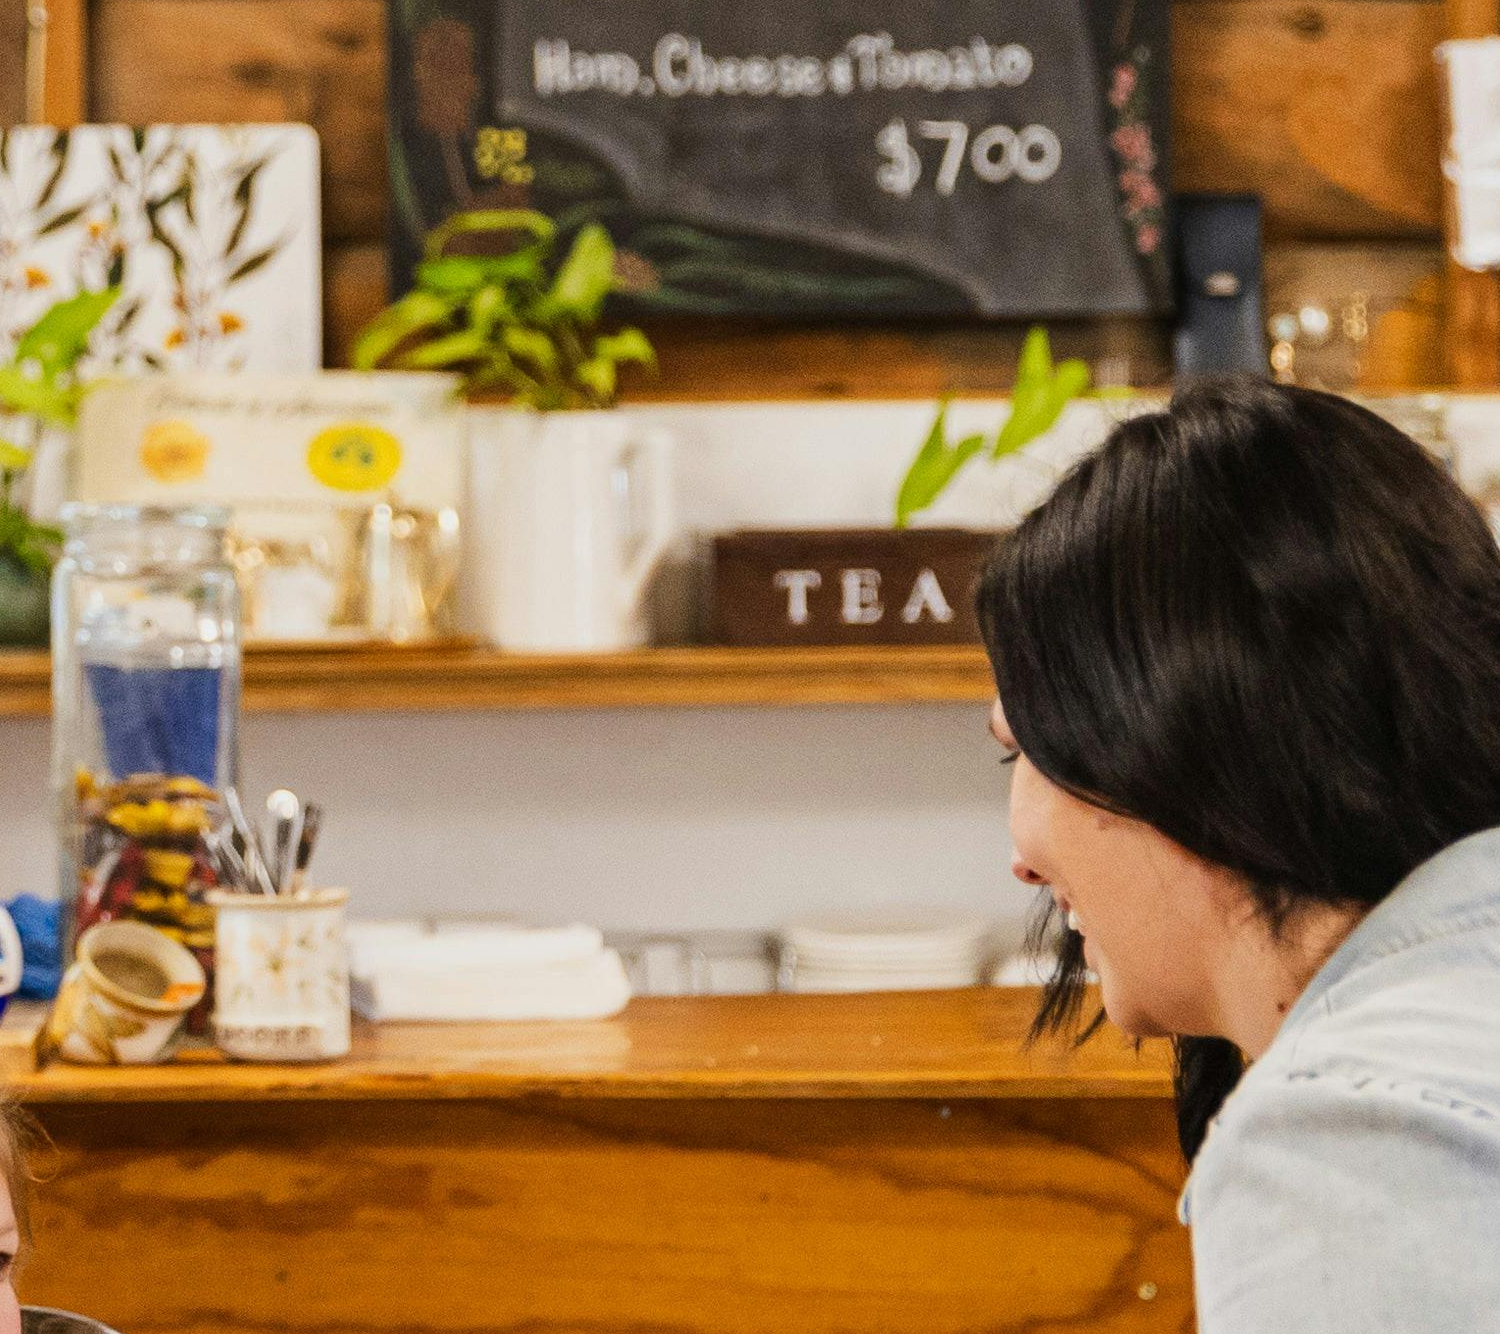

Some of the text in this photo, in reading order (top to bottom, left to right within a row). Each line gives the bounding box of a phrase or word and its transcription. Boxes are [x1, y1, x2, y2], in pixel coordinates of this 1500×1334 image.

[654, 33, 828, 97] Cheese
[850, 33, 1034, 91] Tomato
[775, 569, 954, 624] TEA
